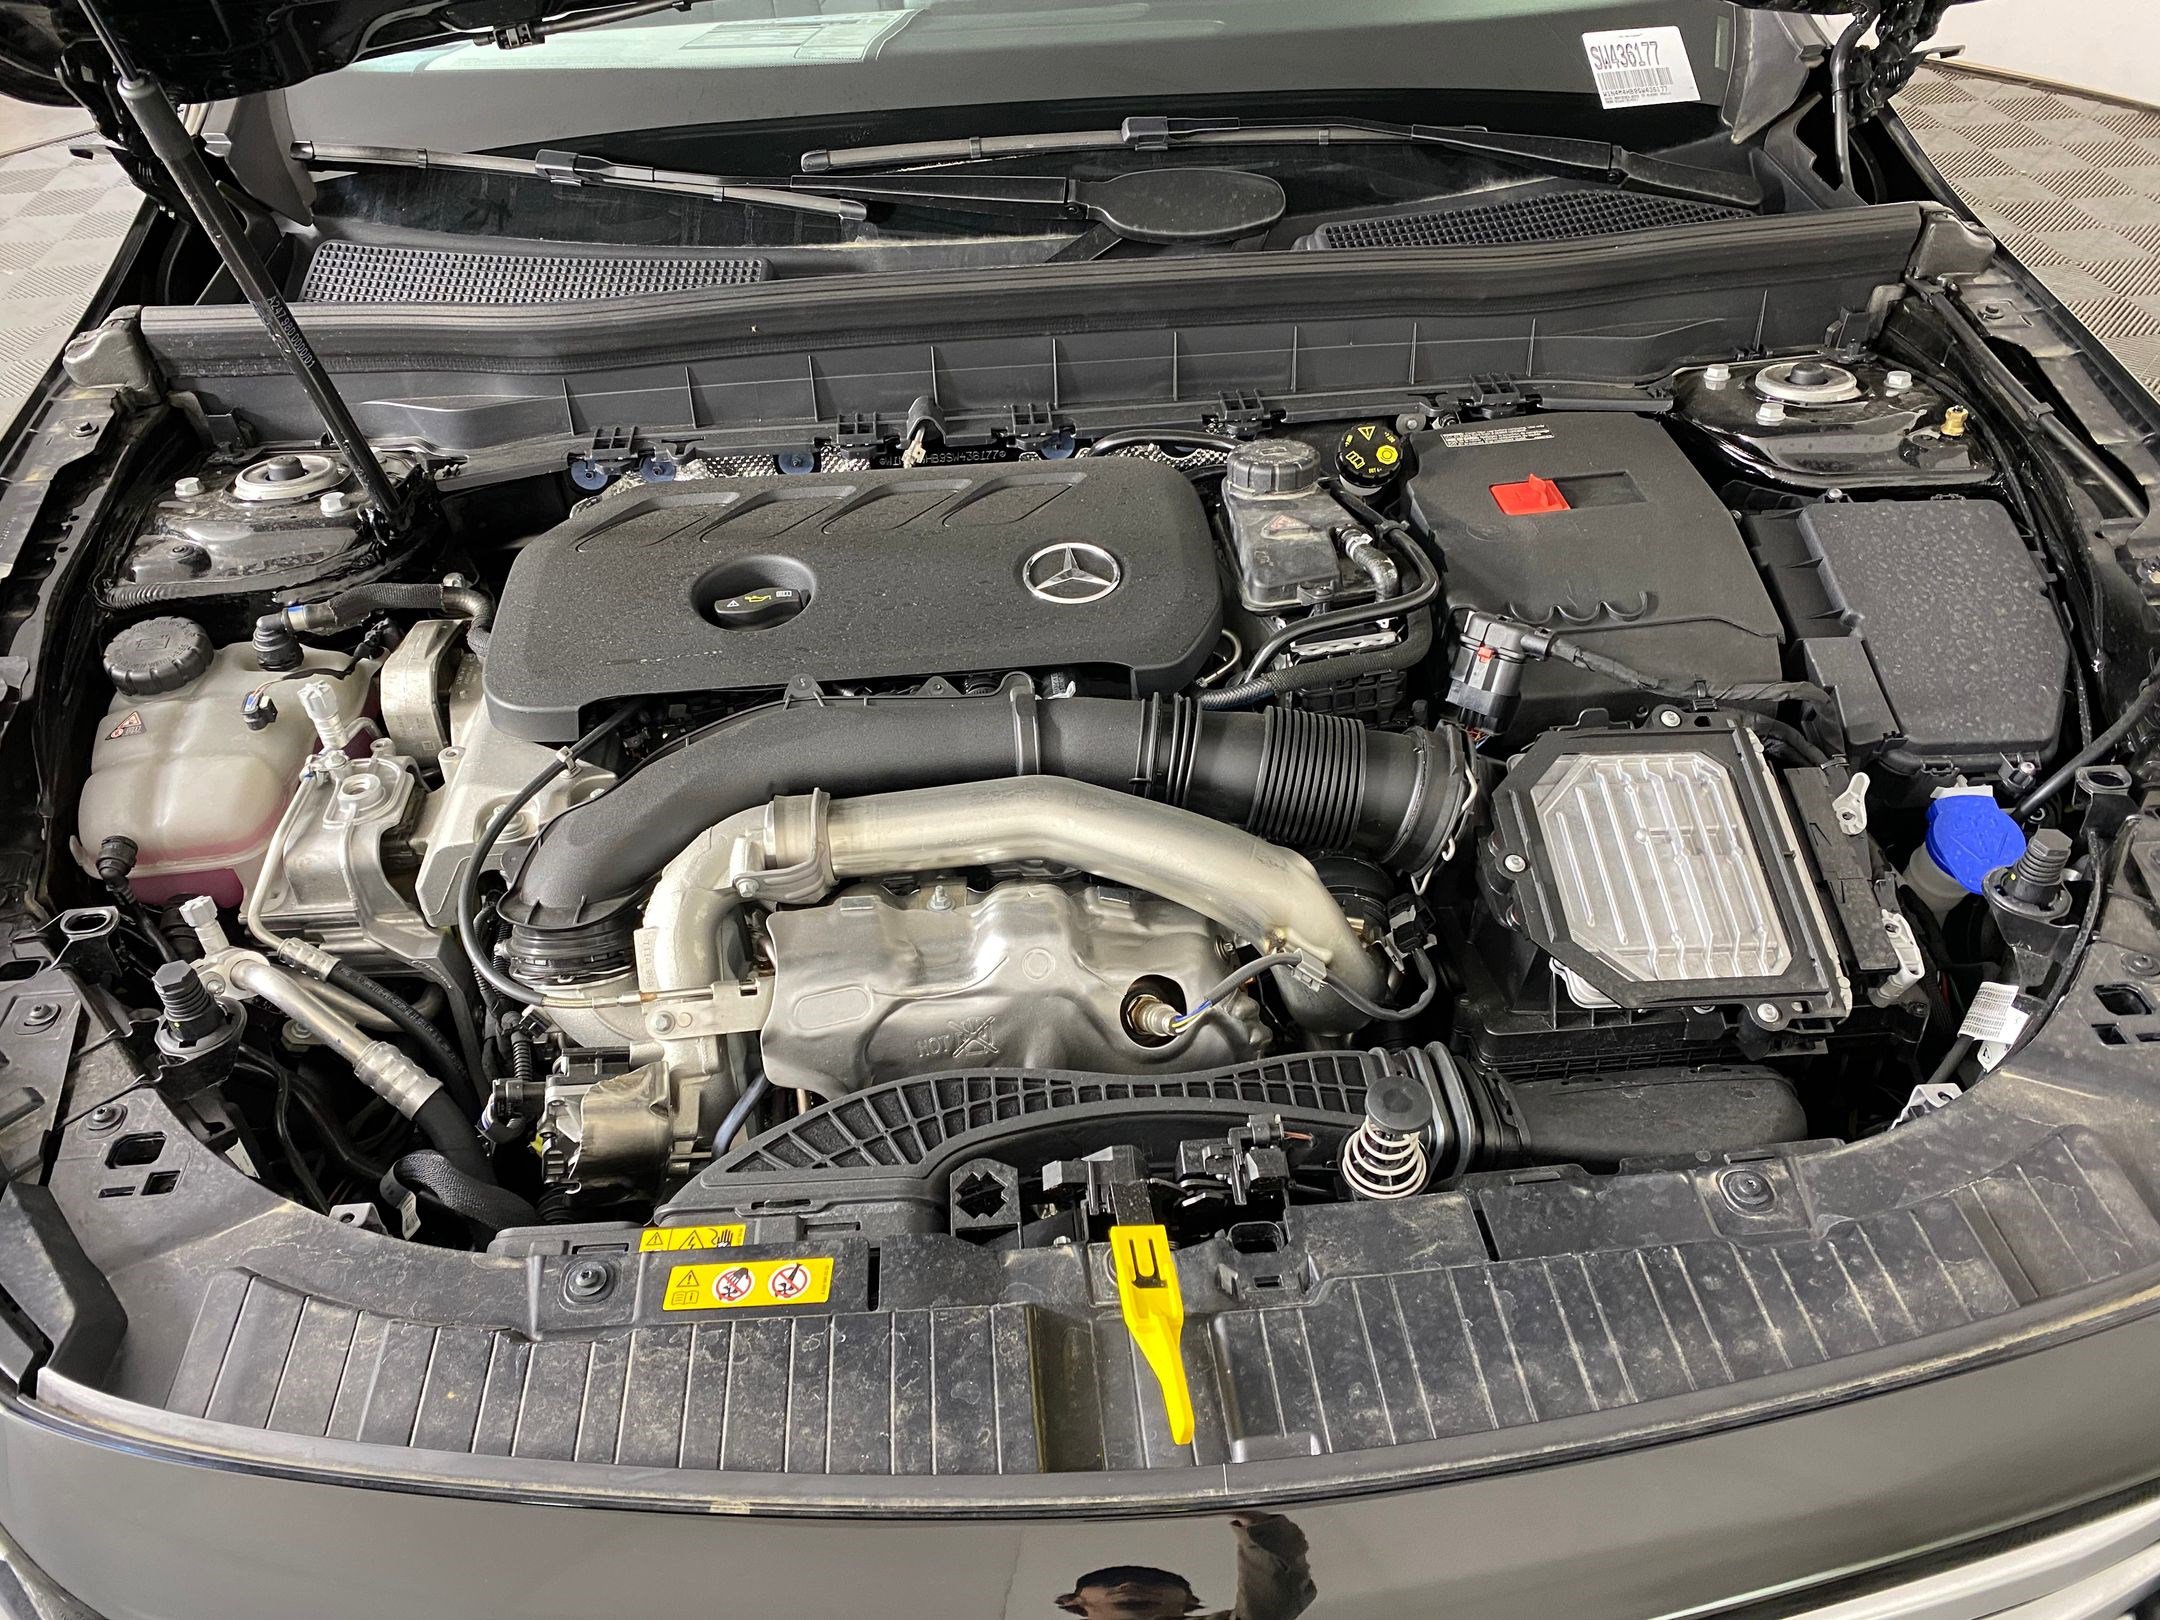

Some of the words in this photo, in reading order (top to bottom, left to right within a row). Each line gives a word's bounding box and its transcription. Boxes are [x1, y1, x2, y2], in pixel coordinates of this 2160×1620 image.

[1590, 41, 1661, 71] SW436177
[267, 296, 287, 319] A247
[281, 318, 296, 336] 980
